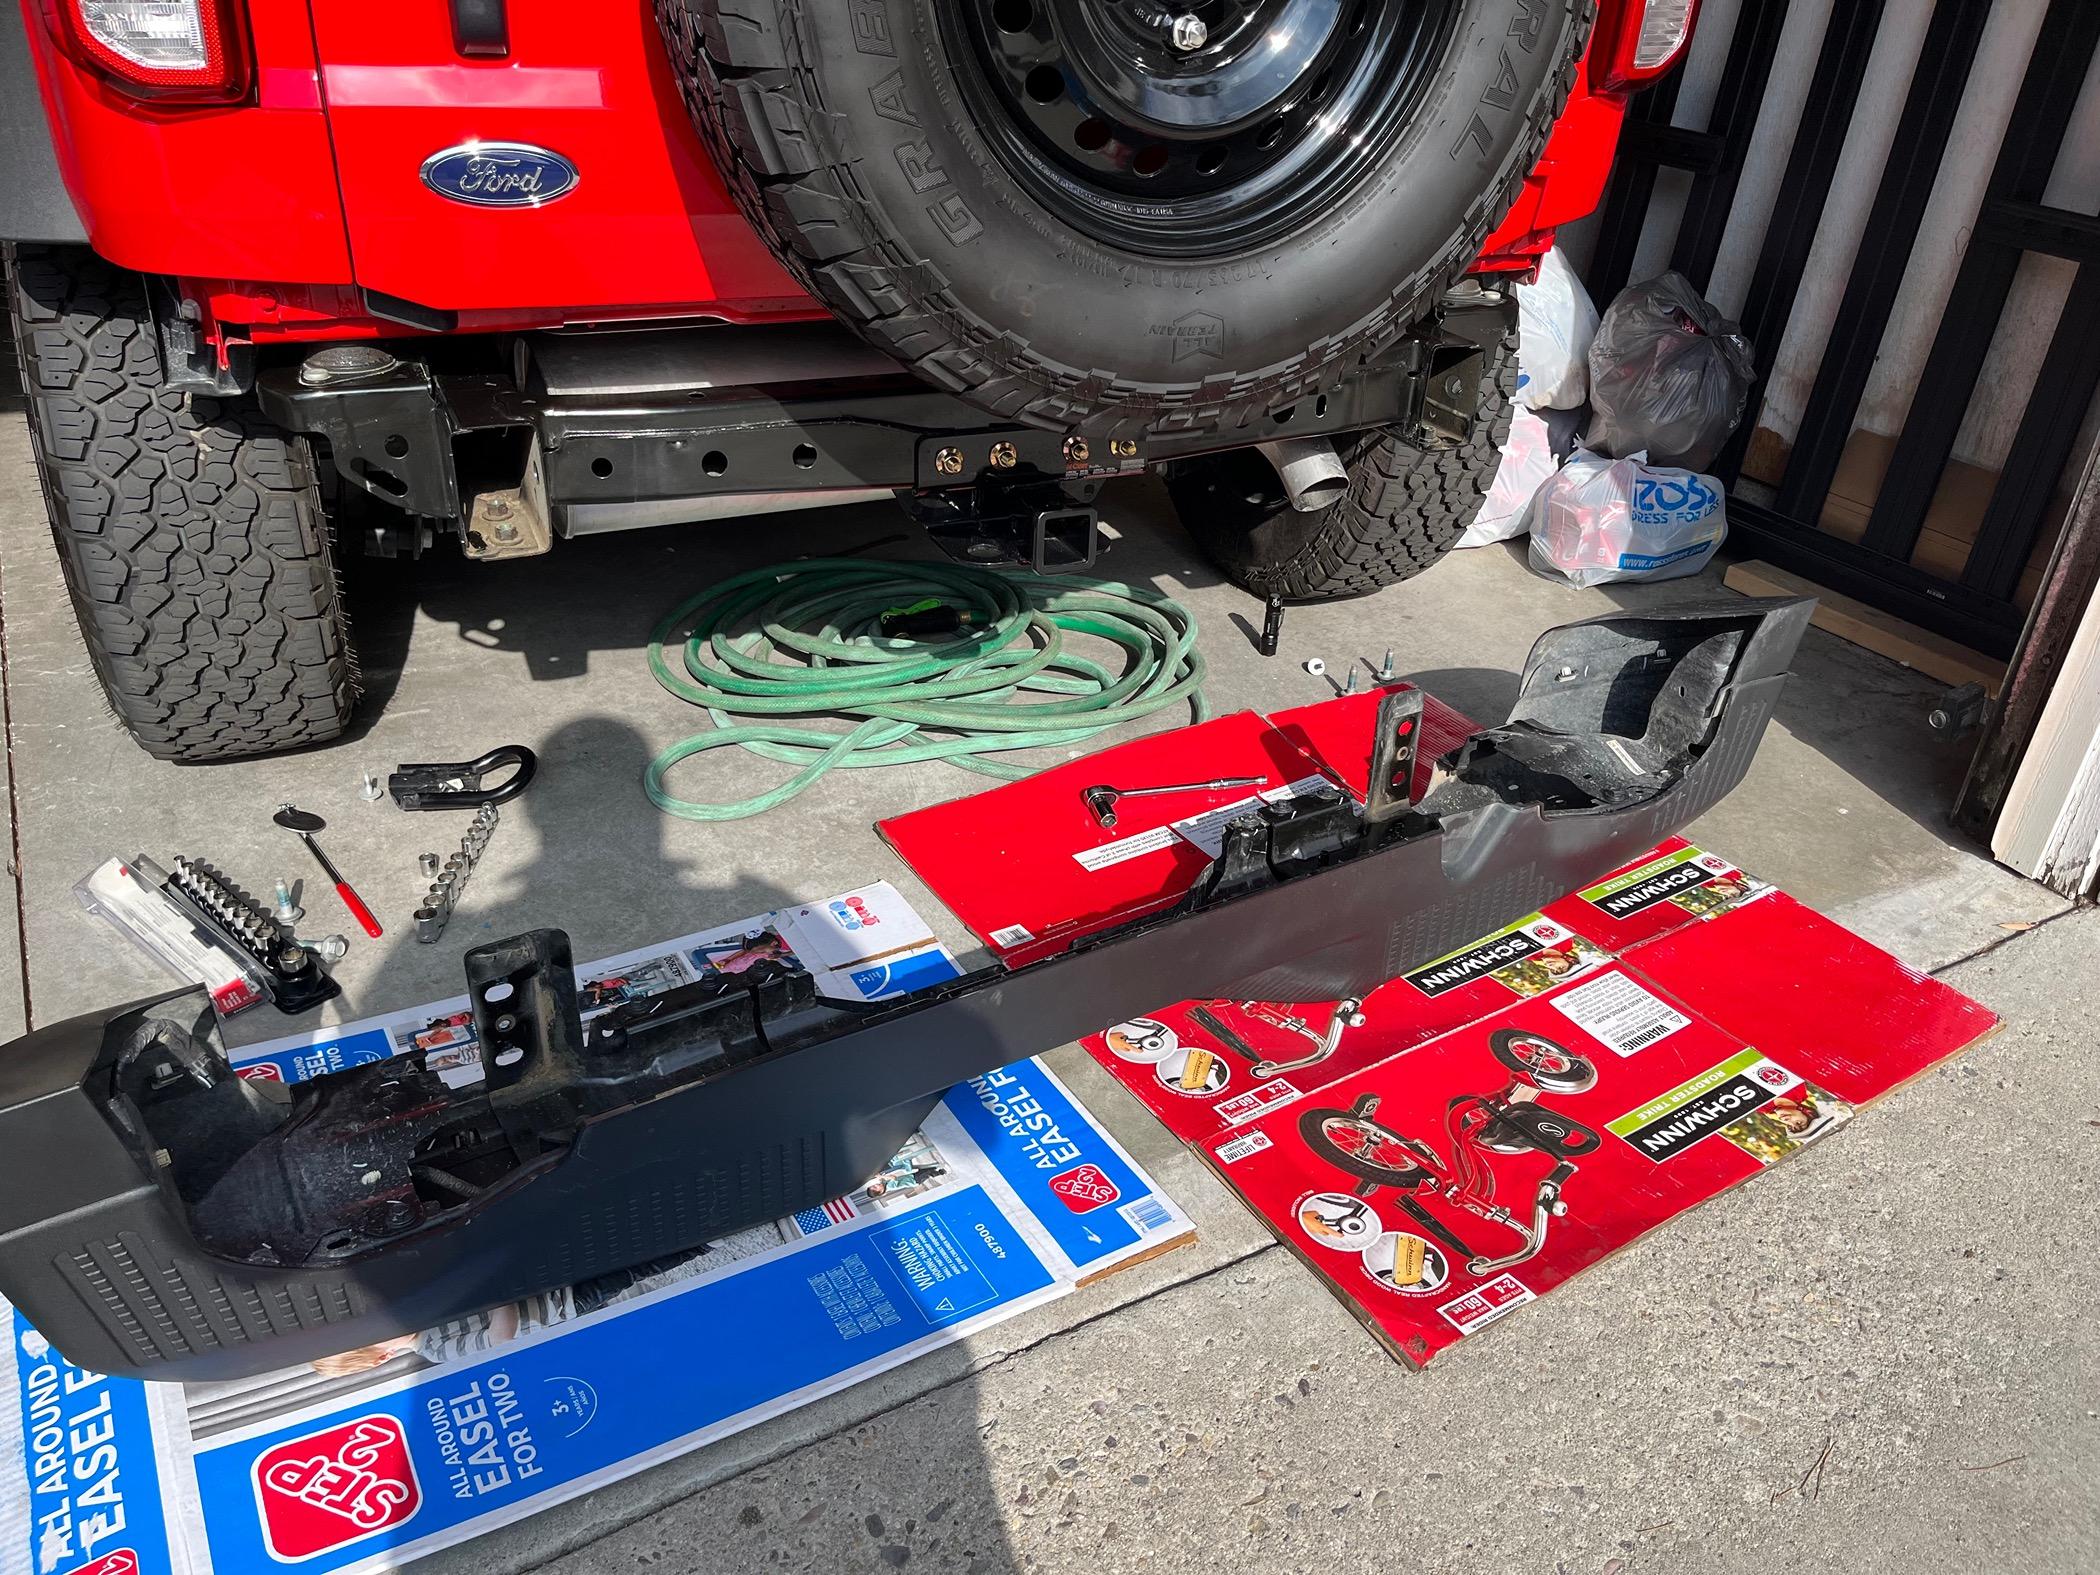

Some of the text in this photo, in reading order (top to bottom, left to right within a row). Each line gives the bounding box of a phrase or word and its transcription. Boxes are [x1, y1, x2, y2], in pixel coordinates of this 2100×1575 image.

[459, 156, 543, 192] Ford
[1676, 512, 1701, 523] FOR
[1602, 877, 1631, 891] TRIKE
[1629, 857, 1677, 880] ROADSTER
[1605, 867, 1702, 912] SCHWINN
[1417, 938, 1532, 988] SCHWINN
[1617, 1023, 1671, 1052] WARNING:
[1236, 1096, 1254, 1107] 60
[1265, 1082, 1287, 1094] 2-4
[1667, 1069, 1727, 1102] ROADSTER
[1006, 1085, 1082, 1165] EASEL
[1634, 1100, 1671, 1121] TRIKE
[1640, 1083, 1758, 1151] SCHWINN
[1021, 1138, 1057, 1169] ALL
[1223, 1143, 1256, 1161] LIFETIME
[974, 1223, 1006, 1259] 487900
[1407, 1236, 1417, 1276] Schwinn
[887, 1237, 937, 1291] WARNING:
[907, 1236, 946, 1282] CHOKING HAZARD
[1393, 1289, 1411, 1298] REAL
[1492, 1277, 1516, 1295] 2-4
[1458, 1309, 1479, 1323] WEIGHT
[1462, 1295, 1483, 1311] 60
[1486, 1296, 1527, 1320] RECOMMENDED
[551, 1399, 570, 1417] 3+
[28, 1363, 69, 1494] AROUND
[449, 1381, 512, 1496] EASEL
[427, 1397, 474, 1499] ALL AROUND
[507, 1428, 544, 1481] FOR
[69, 1389, 127, 1549] EASEL
[265, 1454, 410, 1528] STEP
